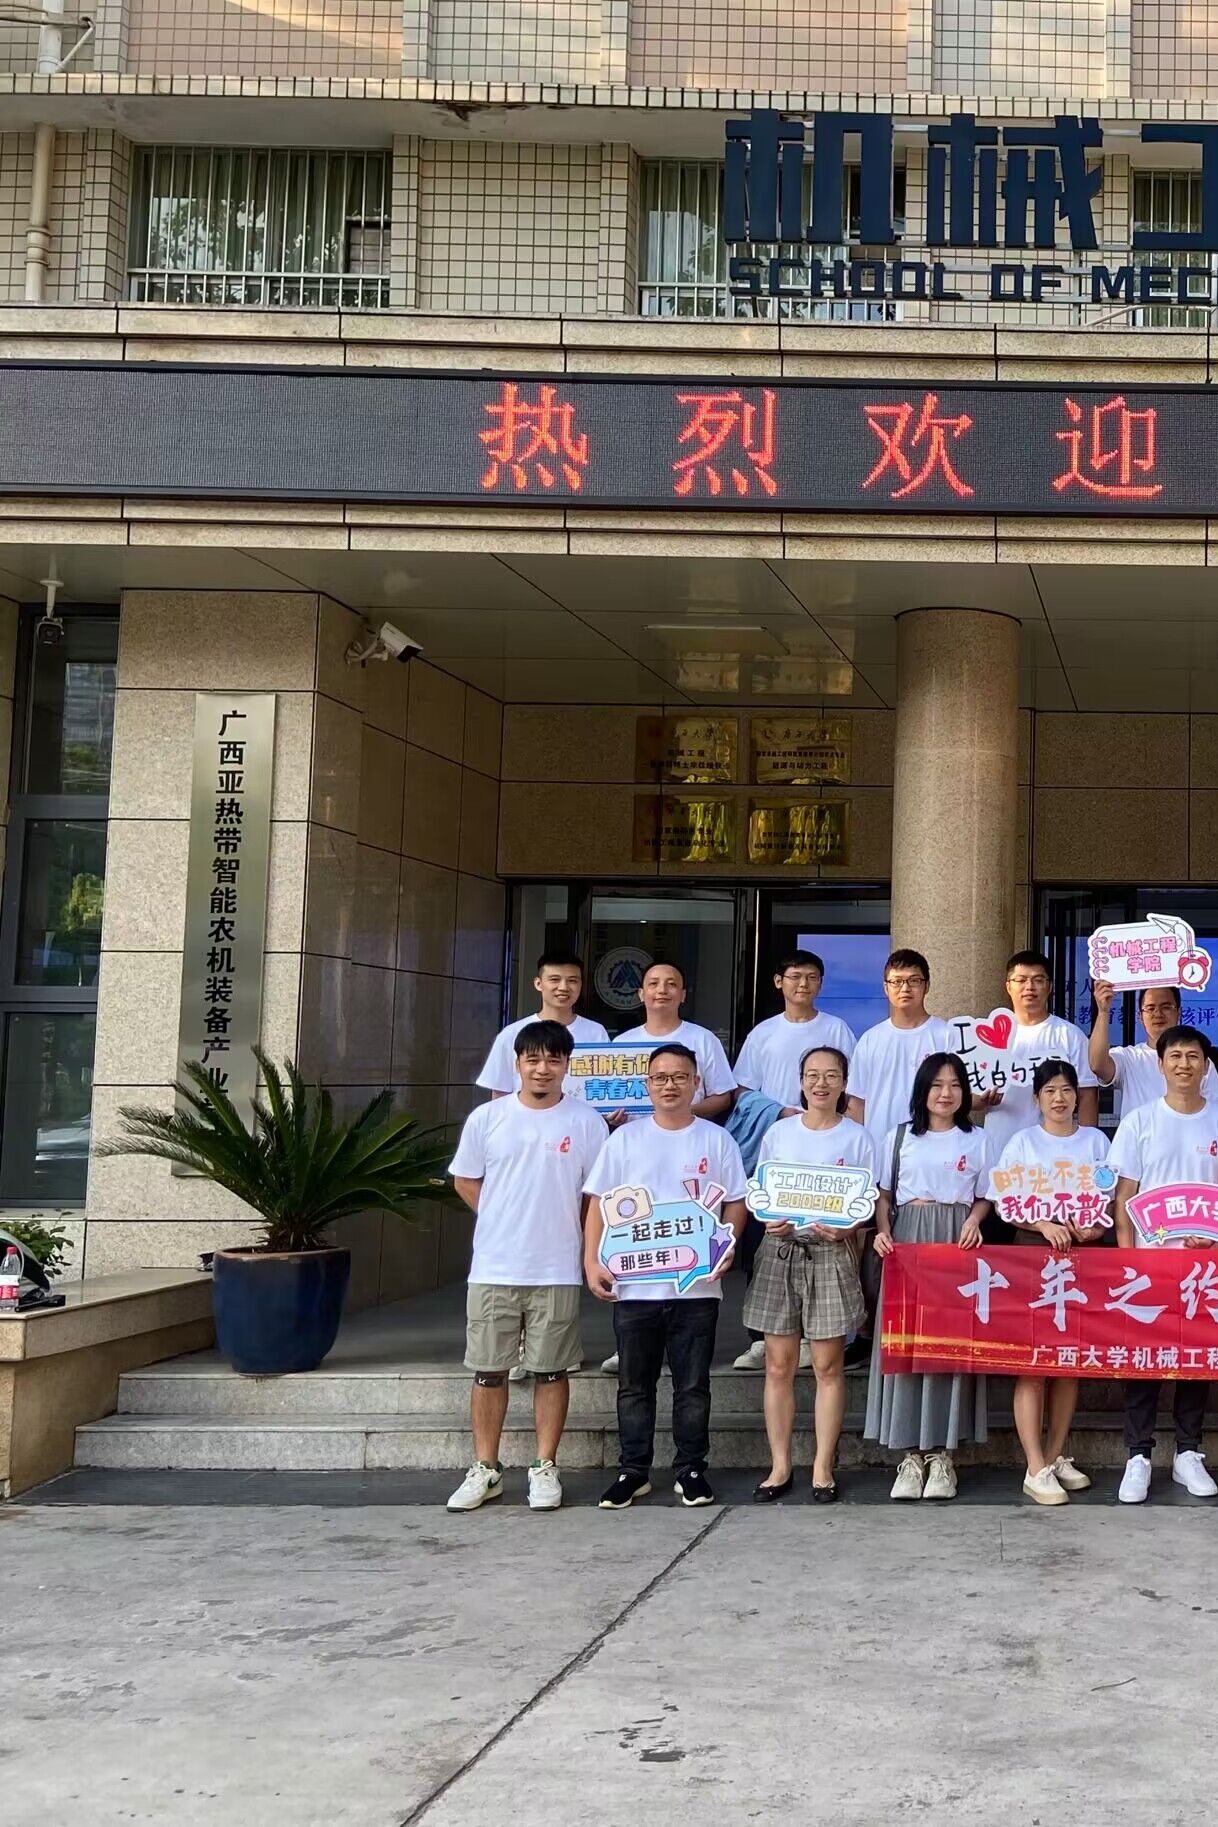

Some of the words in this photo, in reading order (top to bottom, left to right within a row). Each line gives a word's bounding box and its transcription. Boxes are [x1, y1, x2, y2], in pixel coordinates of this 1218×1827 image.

[730, 257, 962, 300] SCHOOL
[990, 263, 1063, 302] OF
[200, 710, 249, 1104] 广西亚热带智能农机装备产业
[1108, 936, 1178, 958] 机械工程
[1127, 955, 1162, 974] 学院
[774, 1171, 854, 1194] 工业设计
[992, 1160, 1095, 1194] 时光不老
[776, 1191, 844, 1214] 2009级
[1002, 1191, 1113, 1228] 我们不散
